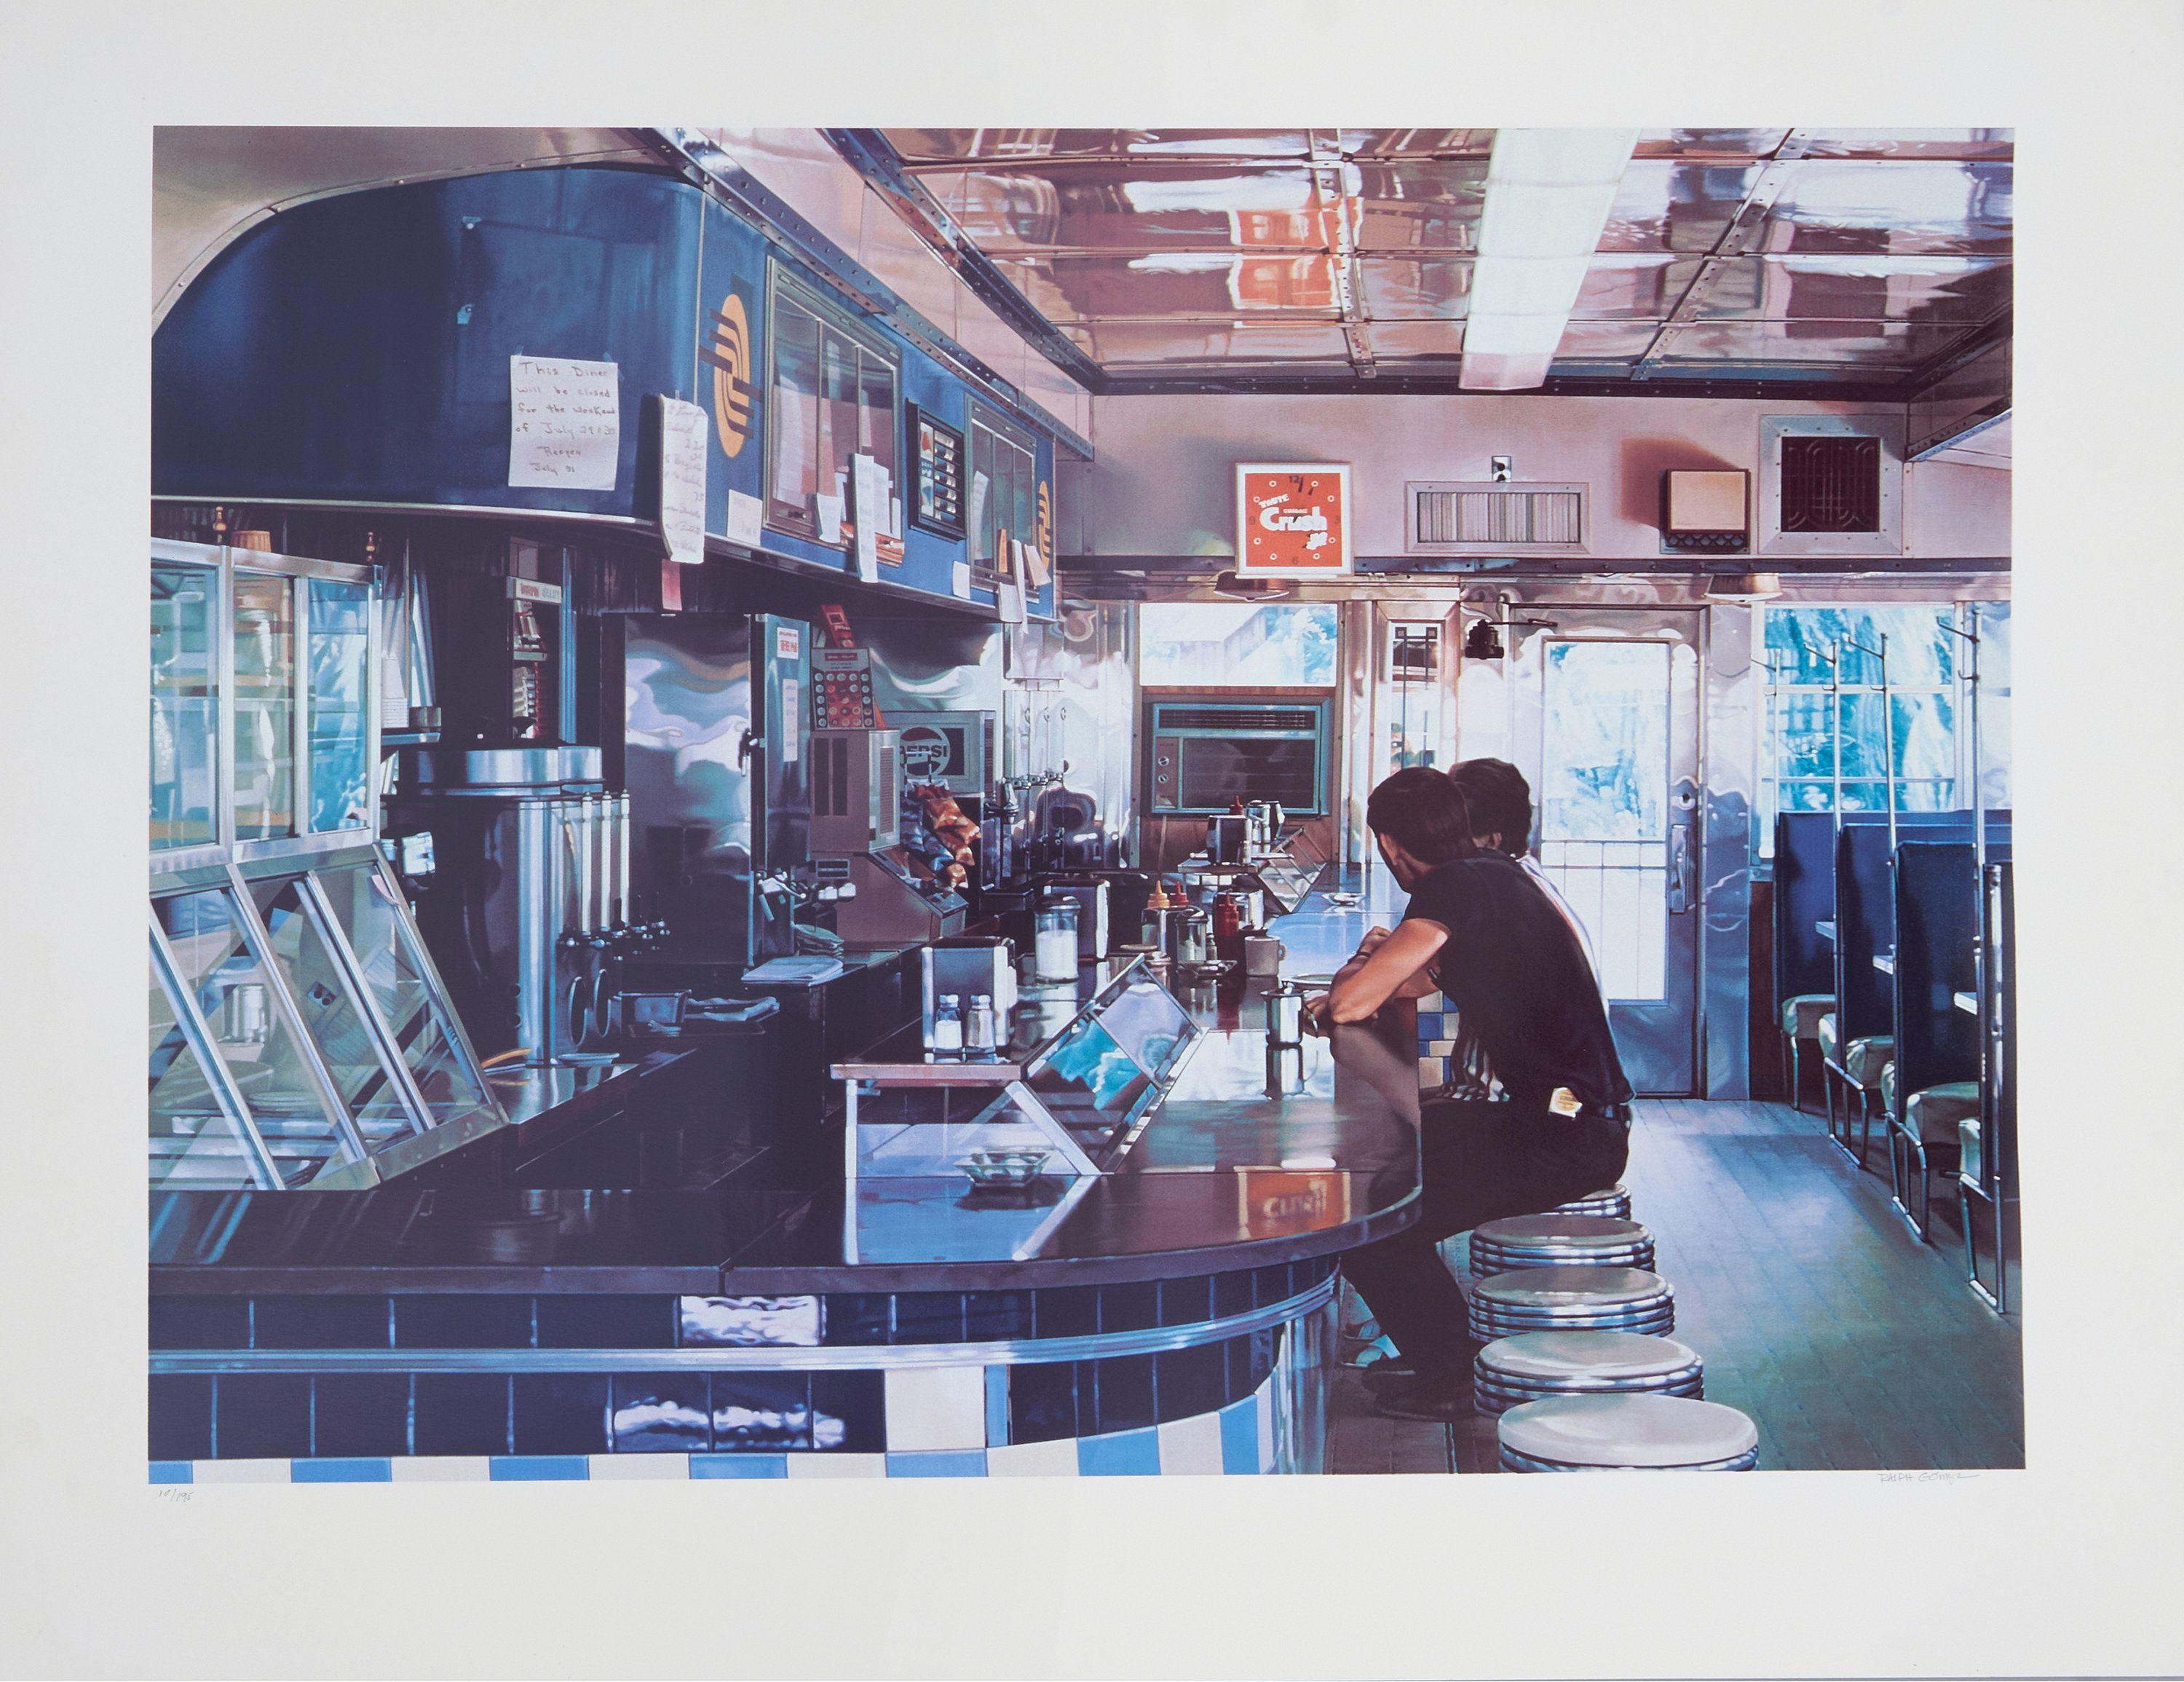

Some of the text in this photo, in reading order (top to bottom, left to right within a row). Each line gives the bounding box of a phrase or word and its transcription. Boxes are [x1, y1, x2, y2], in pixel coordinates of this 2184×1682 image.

[518, 361, 608, 377] This Diner
[515, 386, 611, 398] will be closed
[517, 402, 537, 413] for
[545, 404, 565, 414] the
[515, 422, 529, 433] of
[539, 422, 575, 440] July
[537, 446, 582, 458] Reopen
[529, 462, 559, 476] July
[1289, 475, 1299, 483] 12
[899, 744, 947, 758] PEPSI
